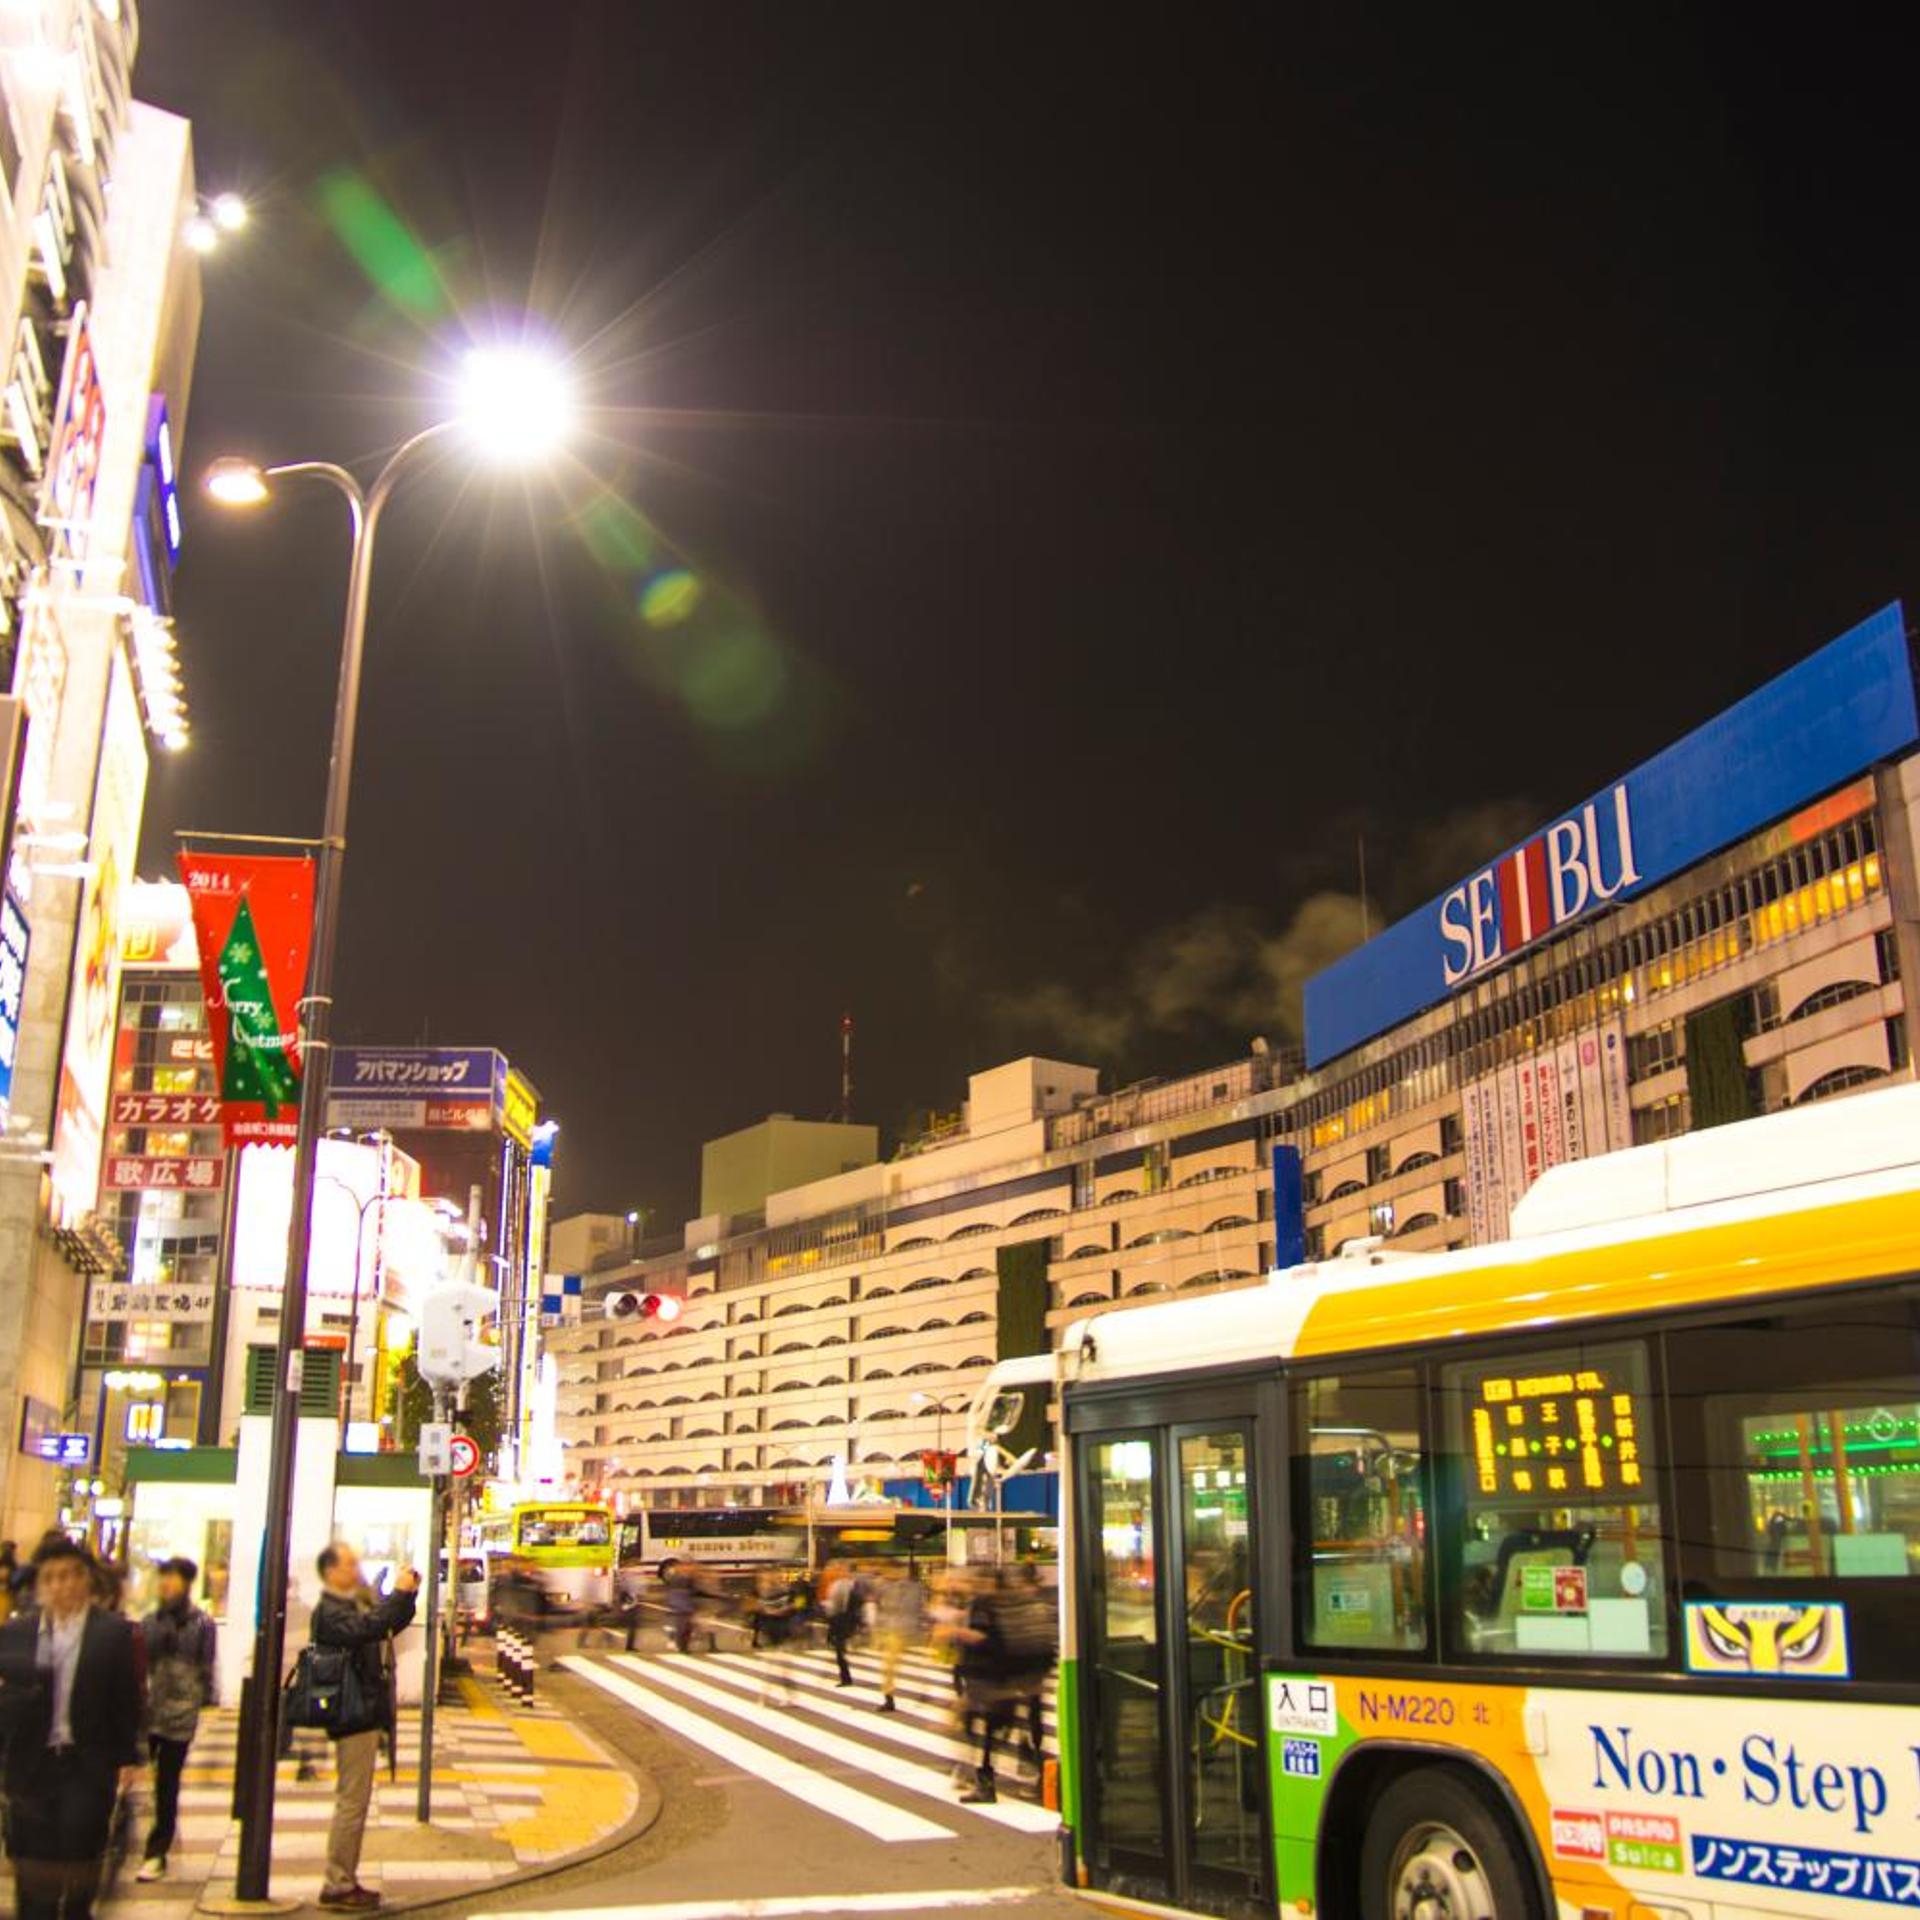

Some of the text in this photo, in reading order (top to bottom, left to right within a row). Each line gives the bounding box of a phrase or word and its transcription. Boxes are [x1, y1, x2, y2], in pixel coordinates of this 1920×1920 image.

[188, 870, 231, 889] 2014
[1440, 784, 1643, 986] SEIBU
[354, 1060, 470, 1082] アパマンショップ
[118, 1097, 222, 1122] カラオケ
[114, 1160, 215, 1185] 歌広場
[1278, 1683, 1328, 1712] 入口
[1359, 1690, 1455, 1726] N-M220
[1609, 1817, 1675, 1842] PASMO
[1615, 1842, 1677, 1869] Suica
[1694, 1841, 1920, 1901] ノンステップバス
